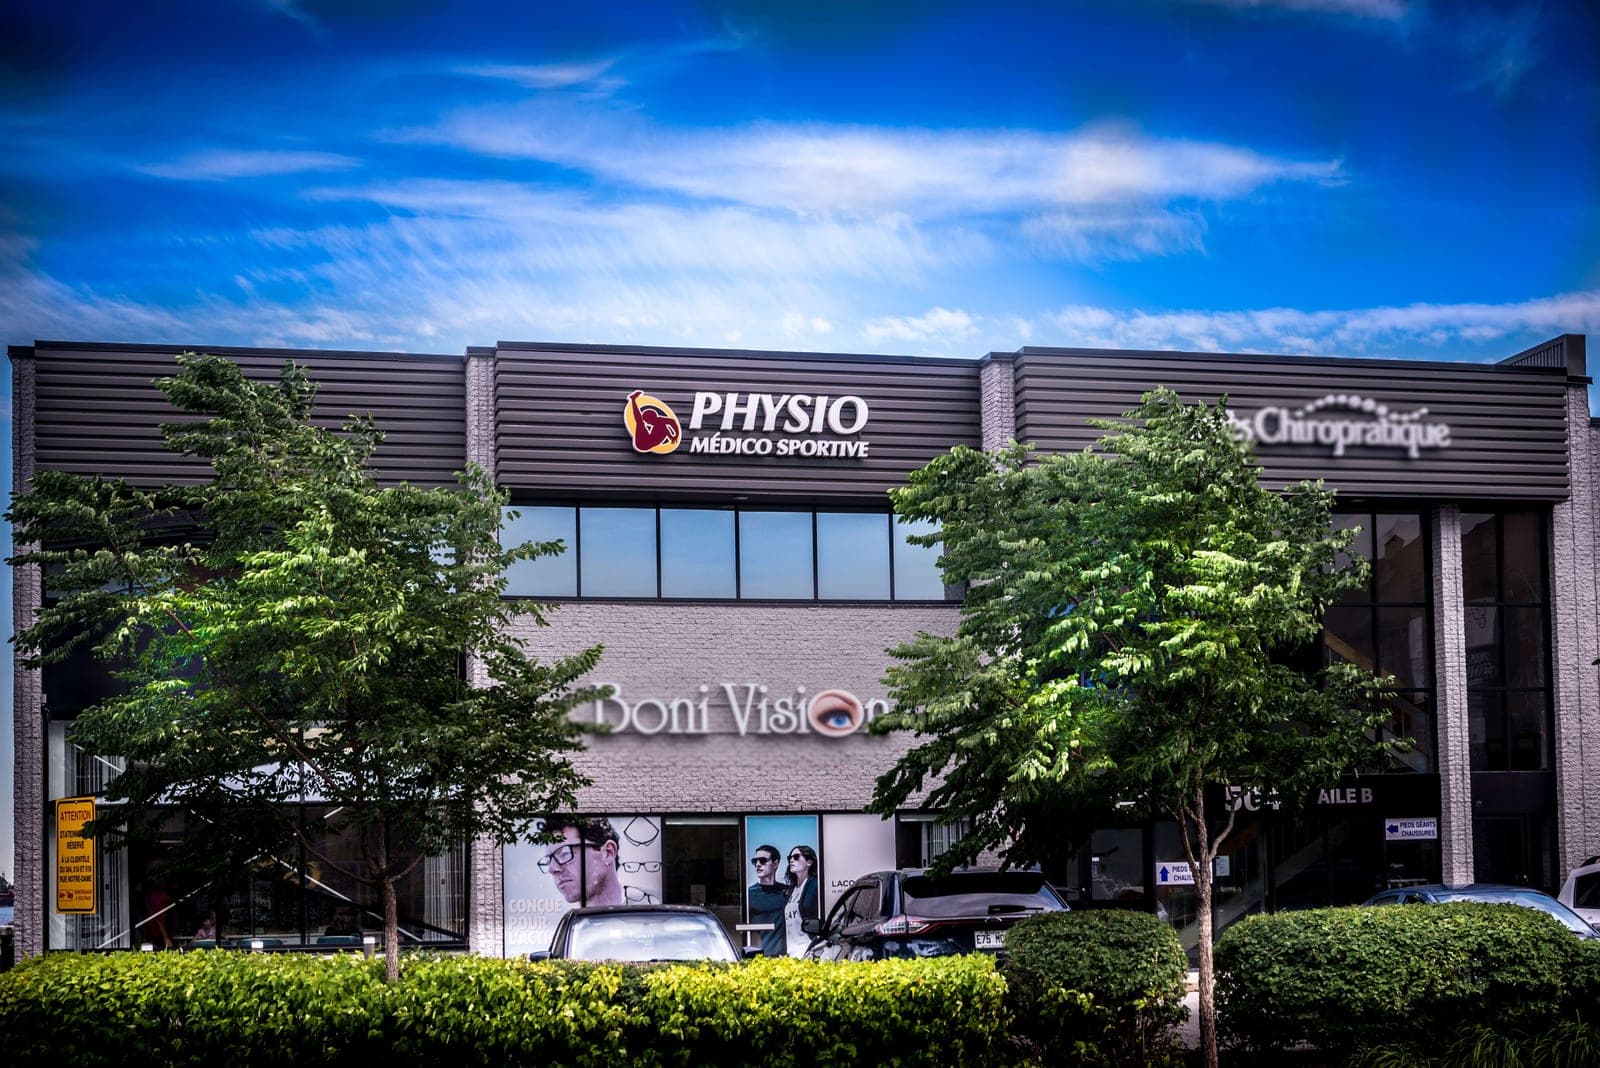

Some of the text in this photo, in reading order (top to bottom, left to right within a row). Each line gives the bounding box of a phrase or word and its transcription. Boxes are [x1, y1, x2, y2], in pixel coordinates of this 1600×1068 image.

[689, 391, 869, 434] PHYSIO
[690, 432, 869, 458] MÉDICO SPORTIVE
[591, 682, 889, 738] Boni Vision
[1317, 787, 1374, 804] AILE B
[60, 810, 91, 821] ATTENTION
[1172, 865, 1187, 873] PIEDS
[509, 897, 563, 915] CONÇUE
[509, 915, 549, 930] POUR
[976, 934, 992, 944] E75
